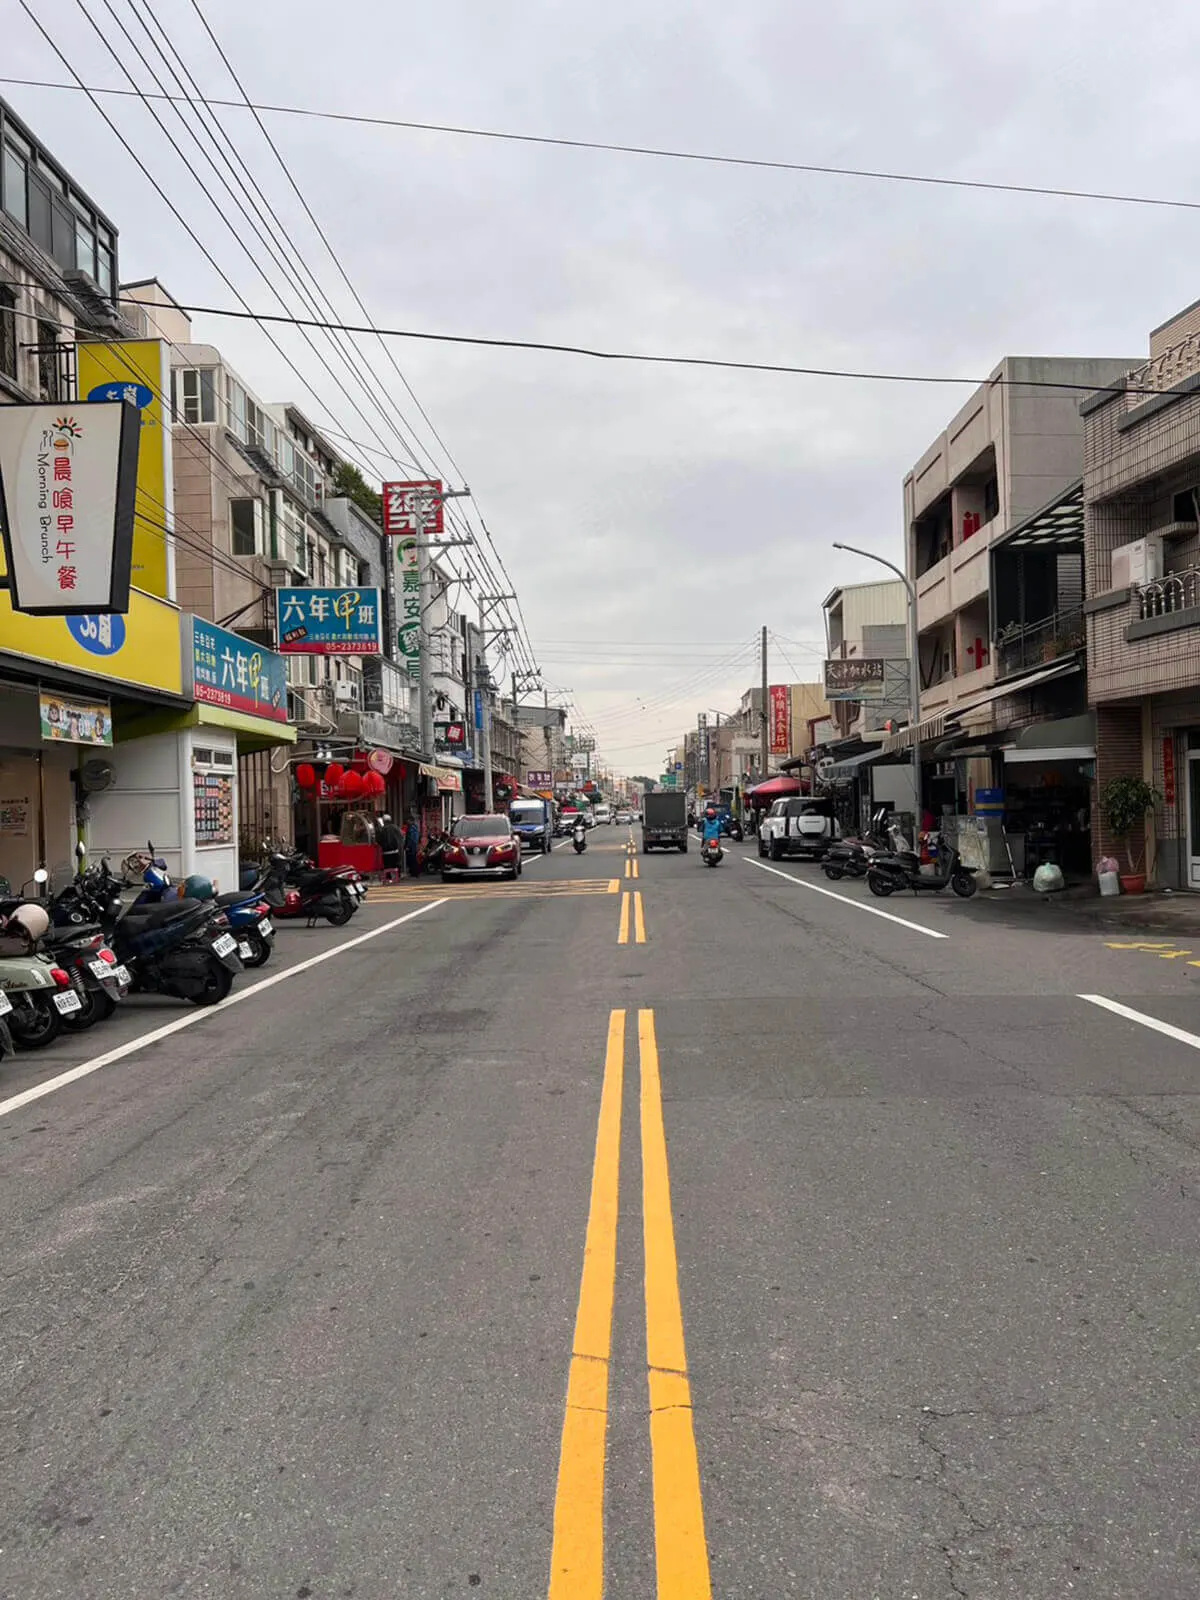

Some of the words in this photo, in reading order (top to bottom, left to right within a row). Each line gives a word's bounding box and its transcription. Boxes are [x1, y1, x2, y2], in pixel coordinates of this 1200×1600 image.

[36, 453, 52, 510] Morning
[40, 514, 54, 564] Brunch
[52, 456, 77, 590] 晨喰早午餐
[282, 591, 375, 631] 六年甲班
[220, 646, 269, 710] 六年甲班
